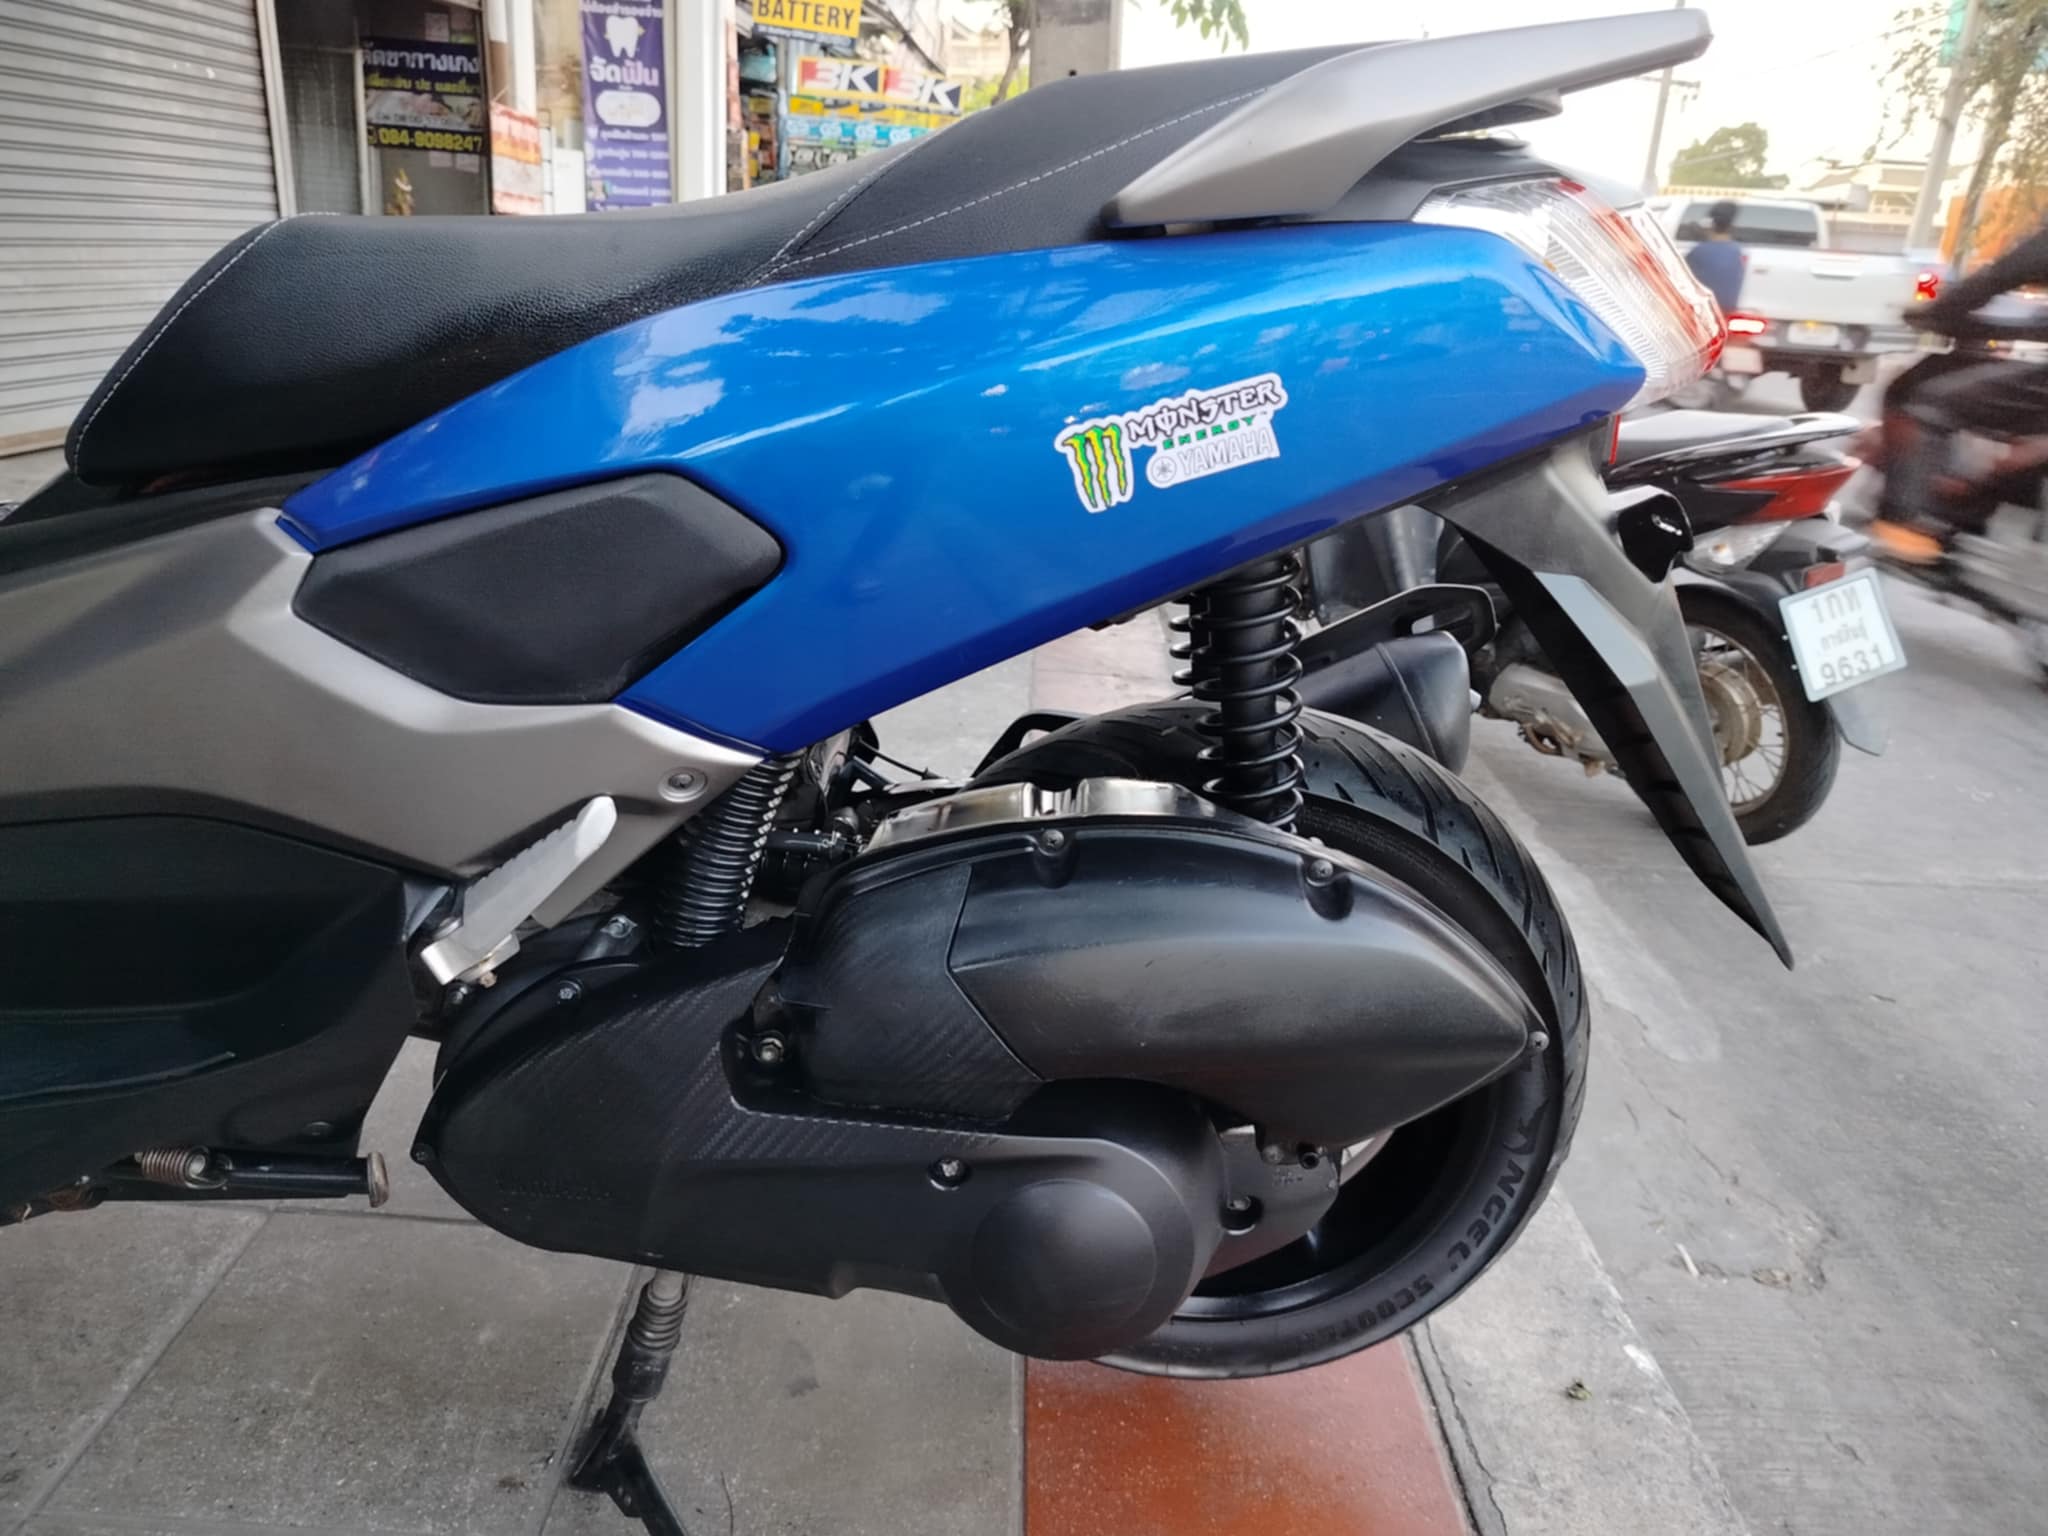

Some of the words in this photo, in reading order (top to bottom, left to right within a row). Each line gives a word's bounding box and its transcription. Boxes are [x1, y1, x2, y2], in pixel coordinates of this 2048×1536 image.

[758, 0, 855, 31] BATTERY
[589, 55, 659, 87] จัดฟัน
[803, 61, 879, 93] 3K
[884, 70, 961, 114] 3K
[1126, 380, 1282, 442] MONSTER
[1162, 414, 1257, 450] ENERGY
[1177, 427, 1273, 476] YAMAHA
[1819, 643, 1884, 685] 9631
